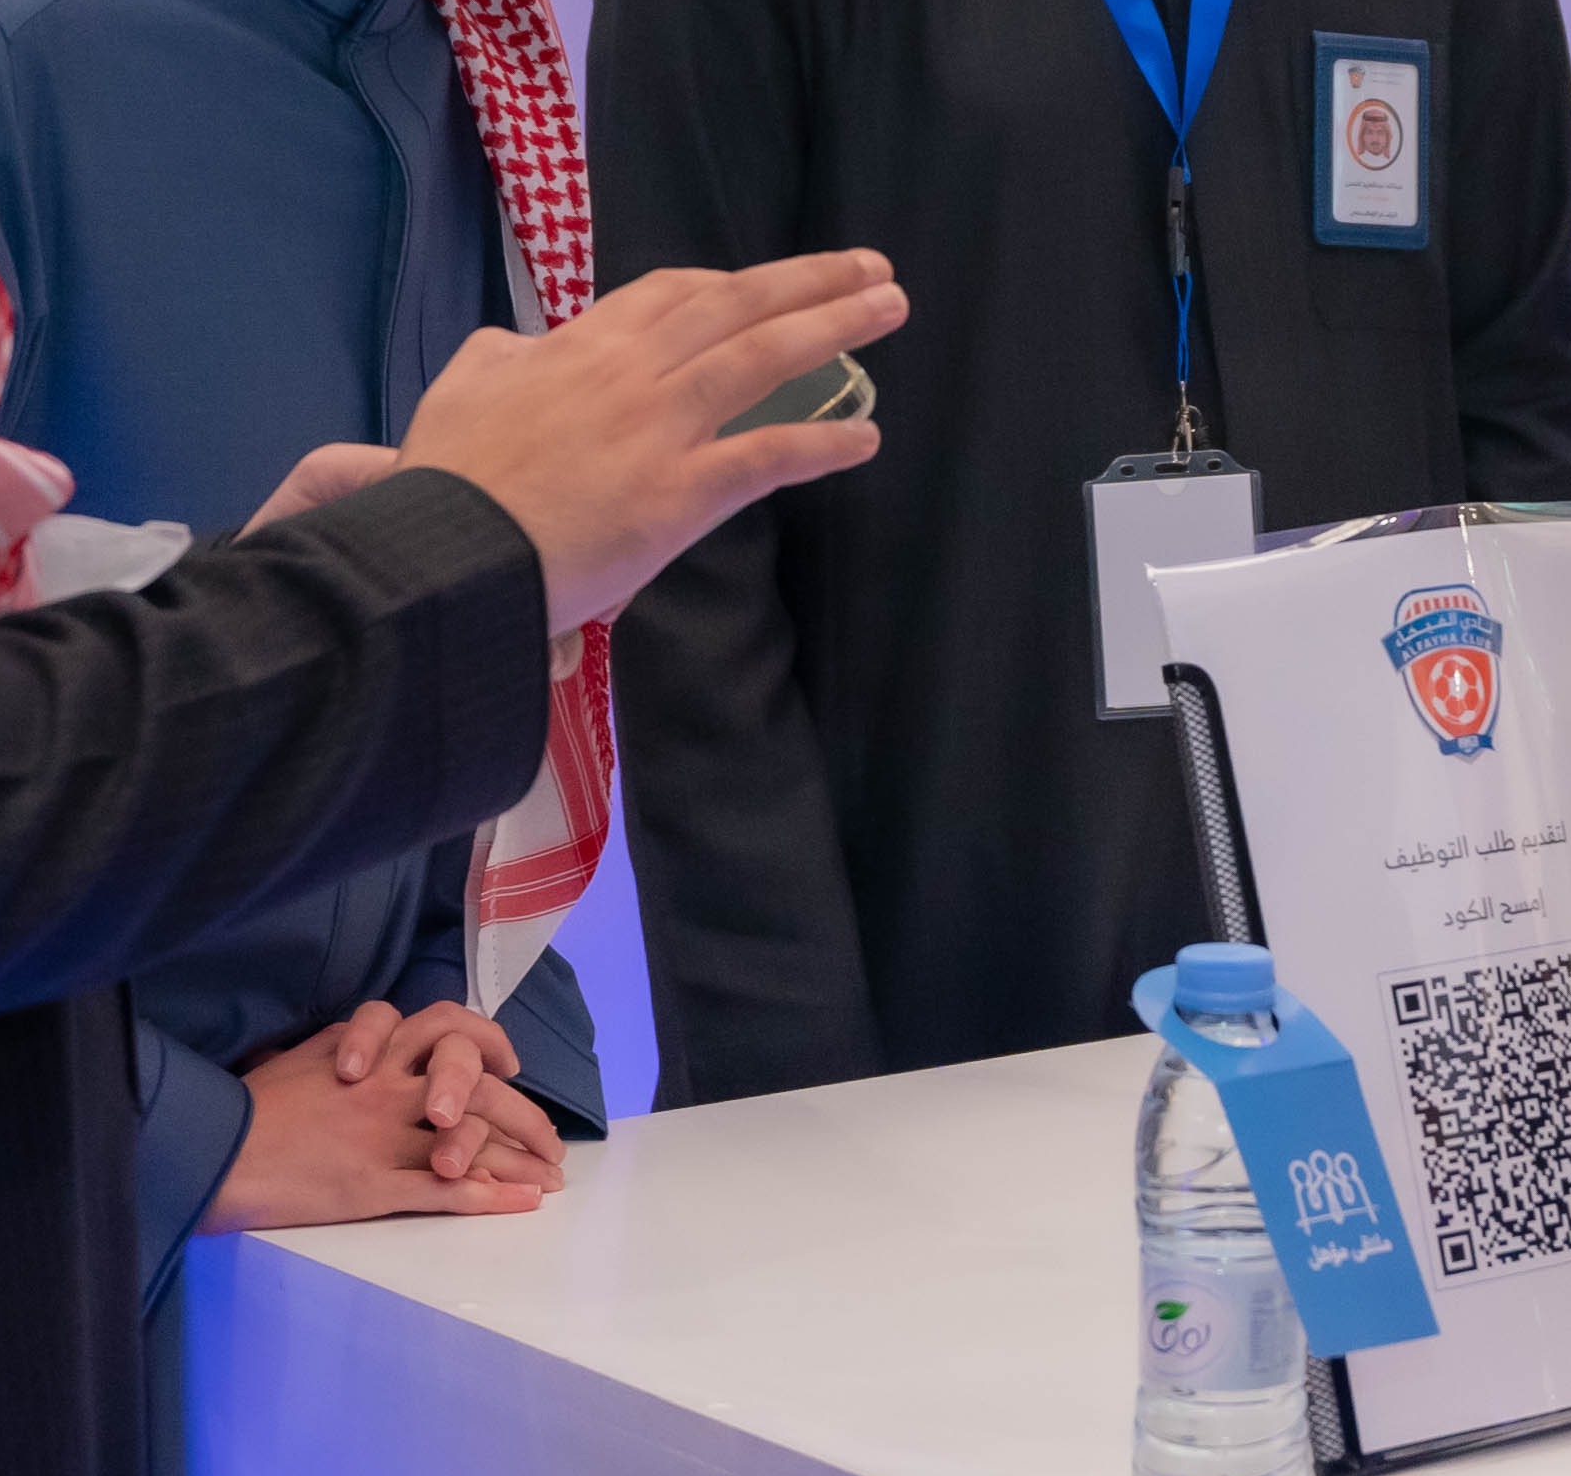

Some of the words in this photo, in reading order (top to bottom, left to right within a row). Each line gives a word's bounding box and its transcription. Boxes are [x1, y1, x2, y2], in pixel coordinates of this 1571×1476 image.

[1401, 631, 1457, 662] ALFAYHA
[1461, 633, 1492, 649] CLUB
[1384, 834, 1469, 873] التوظيف
[1476, 829, 1516, 861] طلب
[1521, 820, 1567, 855] لتقديم
[1444, 896, 1495, 930] الكود
[1308, 1241, 1349, 1271] مؤهل
[1352, 1233, 1393, 1263] ملتقى
